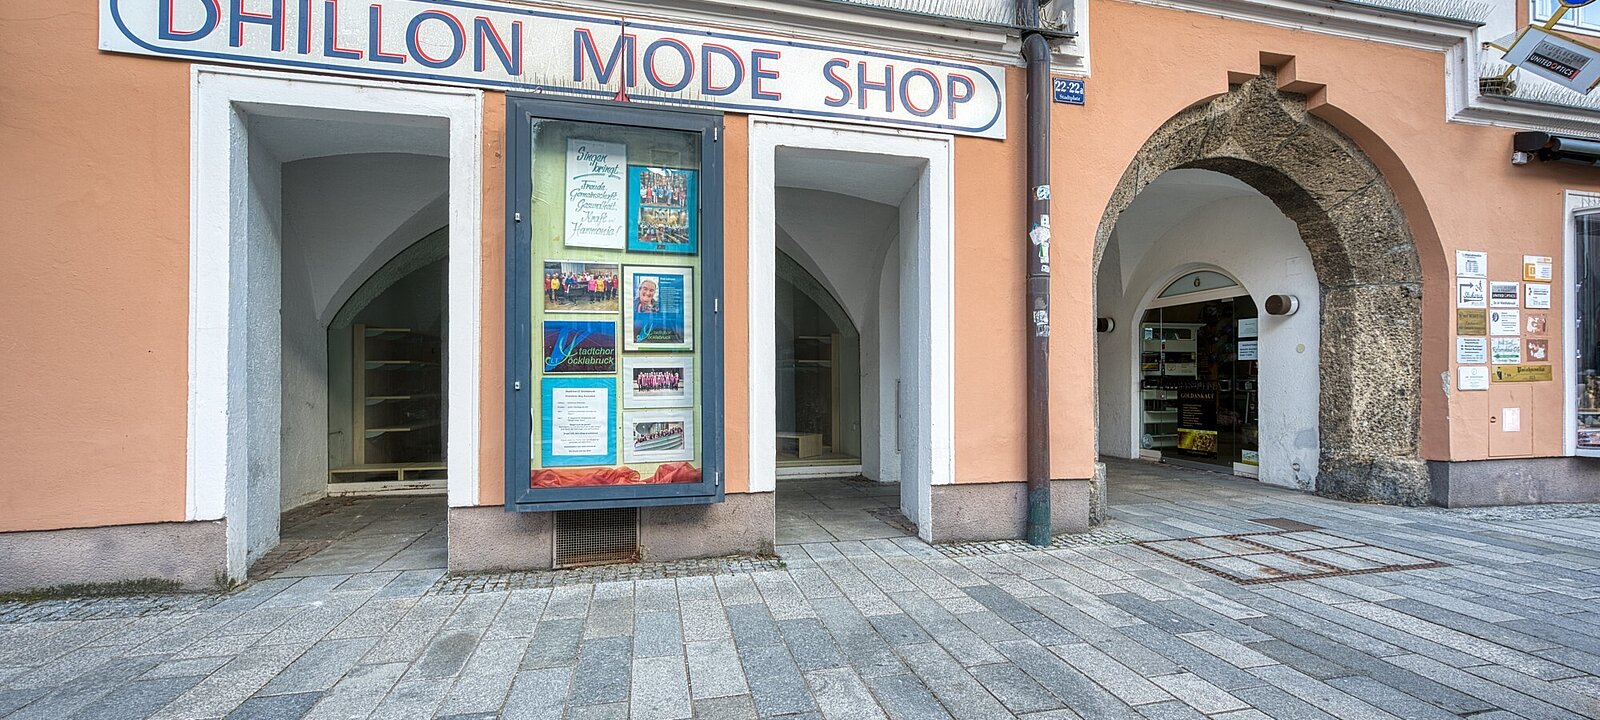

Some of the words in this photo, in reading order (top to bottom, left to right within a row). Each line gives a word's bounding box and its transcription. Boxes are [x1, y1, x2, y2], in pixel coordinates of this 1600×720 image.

[573, 27, 782, 101] MODE
[822, 58, 976, 120] SHOP
[1055, 80, 1083, 94] 22-22a
[577, 146, 608, 166] Singen
[581, 211, 608, 226] Kraft
